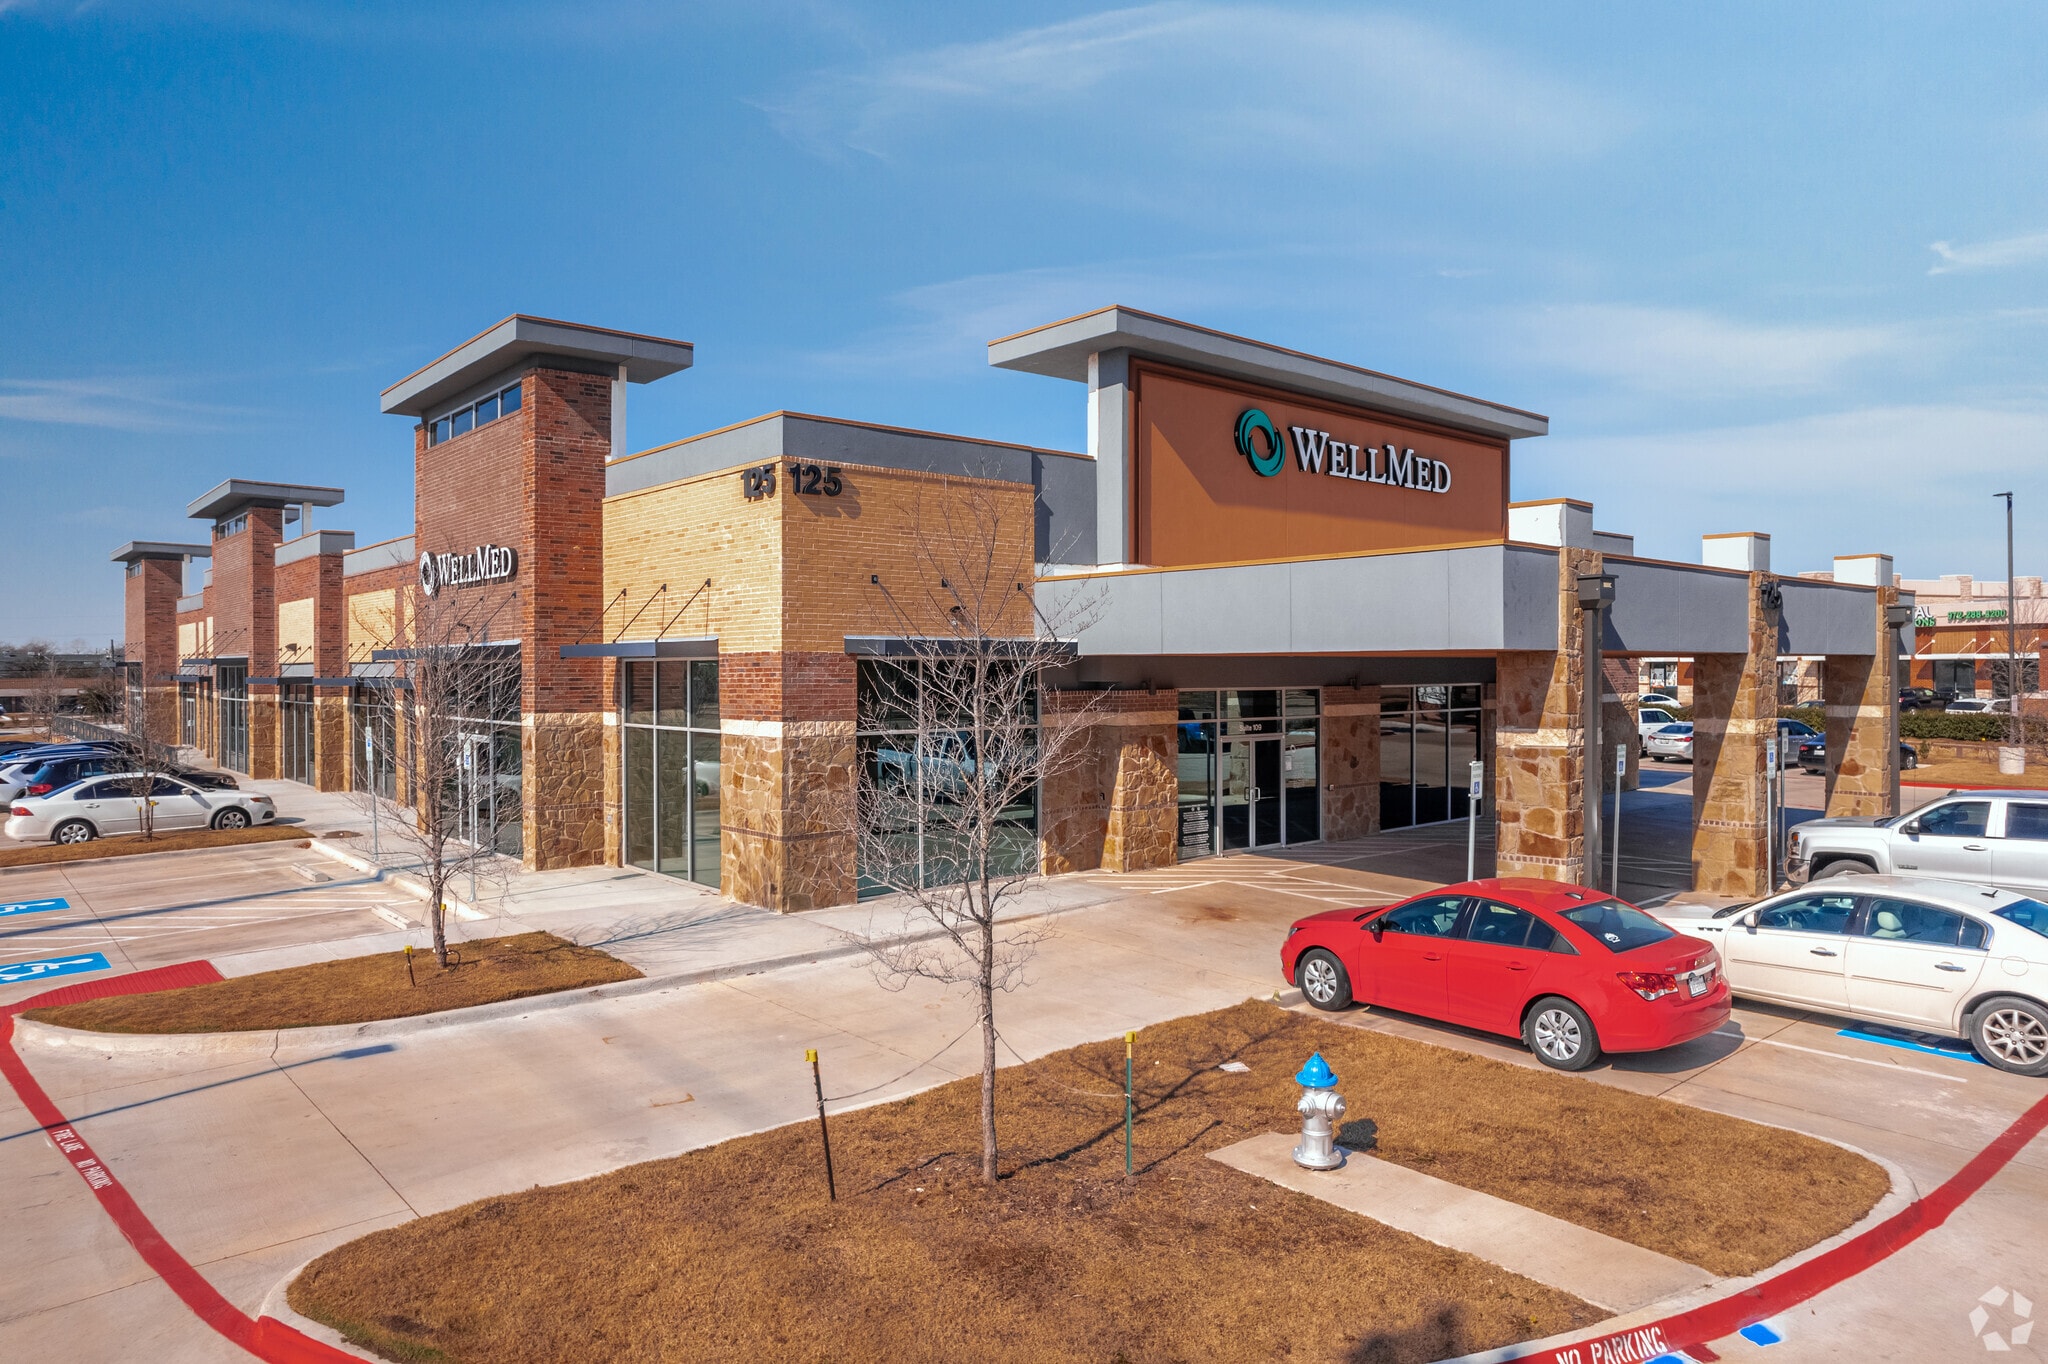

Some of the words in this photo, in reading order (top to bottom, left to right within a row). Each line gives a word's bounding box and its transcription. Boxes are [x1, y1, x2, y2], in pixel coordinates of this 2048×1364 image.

[740, 463, 776, 502] 125
[788, 463, 843, 497] 125
[1252, 723, 1262, 731] 109
[81, 1166, 113, 1189] PARKING
[1590, 1327, 1668, 1364] PARKING
